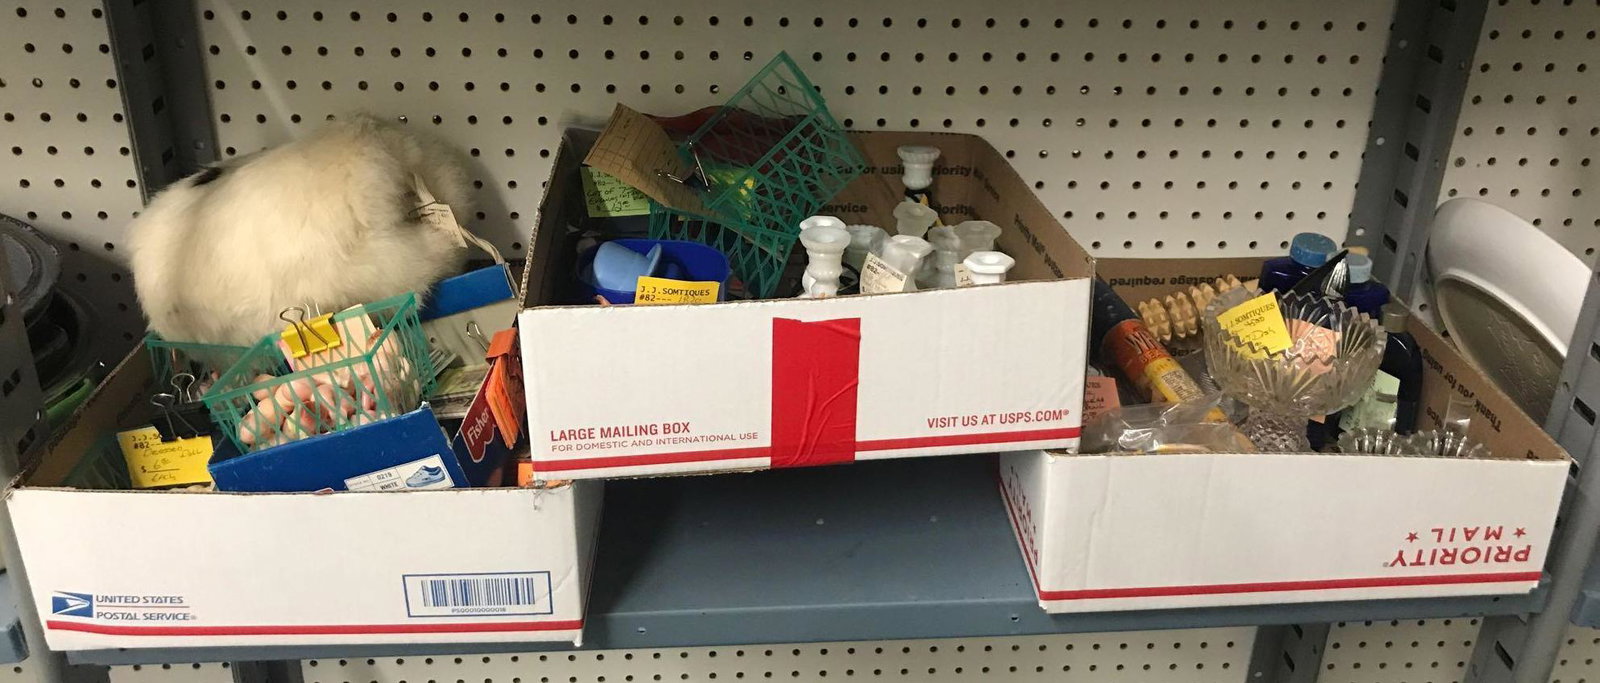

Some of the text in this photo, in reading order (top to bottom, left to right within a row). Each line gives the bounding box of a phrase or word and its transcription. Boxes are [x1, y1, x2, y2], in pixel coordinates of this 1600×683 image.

[467, 408, 490, 446] Fisher
[927, 416, 959, 429] VISIT
[961, 415, 978, 427] US
[981, 414, 997, 426] AT
[550, 421, 691, 442] LARGE MAILING BOX
[551, 431, 759, 452] FOR DOMESTIC AND INTERNATIONAL USE
[1431, 525, 1503, 543] MAIL
[96, 595, 184, 604] UNITED STATES
[96, 612, 140, 620] POSTAL
